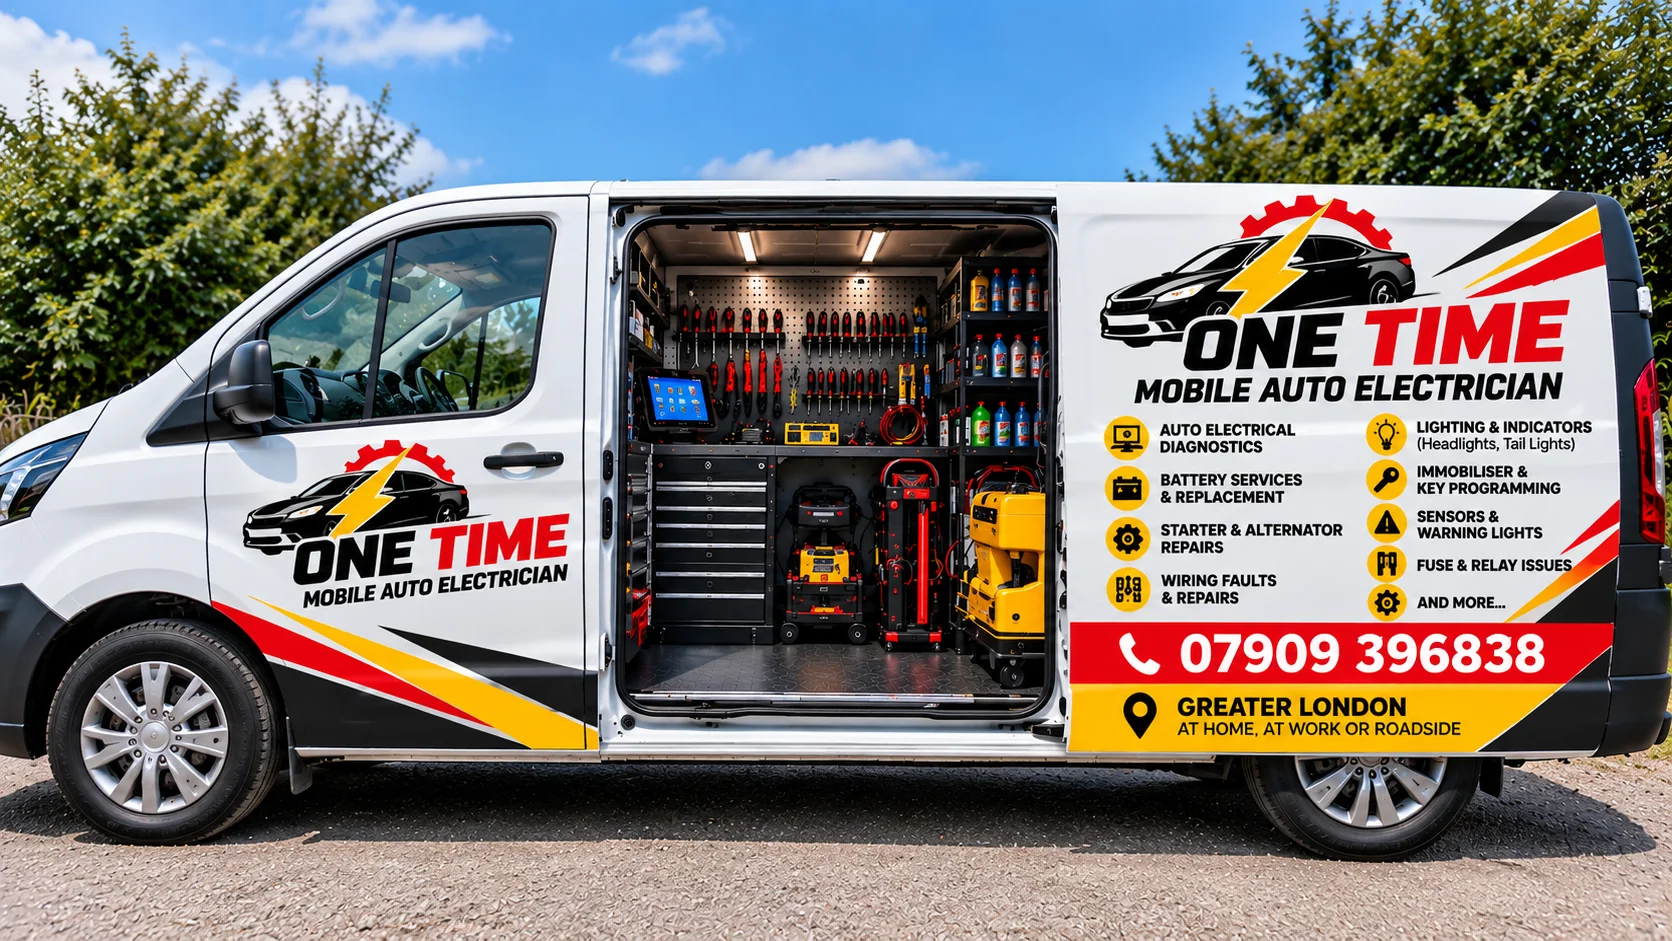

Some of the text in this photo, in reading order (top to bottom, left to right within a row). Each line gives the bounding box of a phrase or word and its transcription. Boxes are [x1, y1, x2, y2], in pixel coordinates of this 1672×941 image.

[1183, 299, 1571, 371] ONE TIME
[1134, 371, 1564, 404] MOBILE AUTO ELECTRICIAN
[1159, 423, 1296, 438] AUTO ELECTRICAL
[1416, 420, 1593, 435] LIGHTING & INDICATORS
[1160, 440, 1263, 455] DIAGNOSTICS
[1417, 436, 1576, 454] (Headlights, Tail Lights)
[1417, 465, 1528, 479] IMMOBILISER &
[1160, 473, 1303, 488] BATTERY SERVICES
[1417, 481, 1561, 496] KEY PROGRAMMING
[1160, 490, 1285, 505] & REPLACEMENT
[1417, 510, 1499, 524] SENSORS &
[1160, 523, 1343, 538] STARTER & ALTERNATOR
[1417, 526, 1543, 540] WARNING LIGHTS
[293, 513, 571, 586] ONE TIME
[1161, 540, 1224, 555] REPAIRS
[1417, 558, 1573, 573] FUSE & RELAY ISSUES
[302, 563, 569, 609] MOBILE AUTO ELECTRICIAN
[1160, 574, 1277, 588] WIRING FAULTS
[1161, 591, 1239, 606] & REPAIRS
[1417, 596, 1506, 610] AND MORE...
[1180, 633, 1545, 674] 07909 396838
[1177, 696, 1407, 717] GREATER LONDON
[1177, 721, 1461, 737] AT HOME, AT WORK OR ROADSIDE
